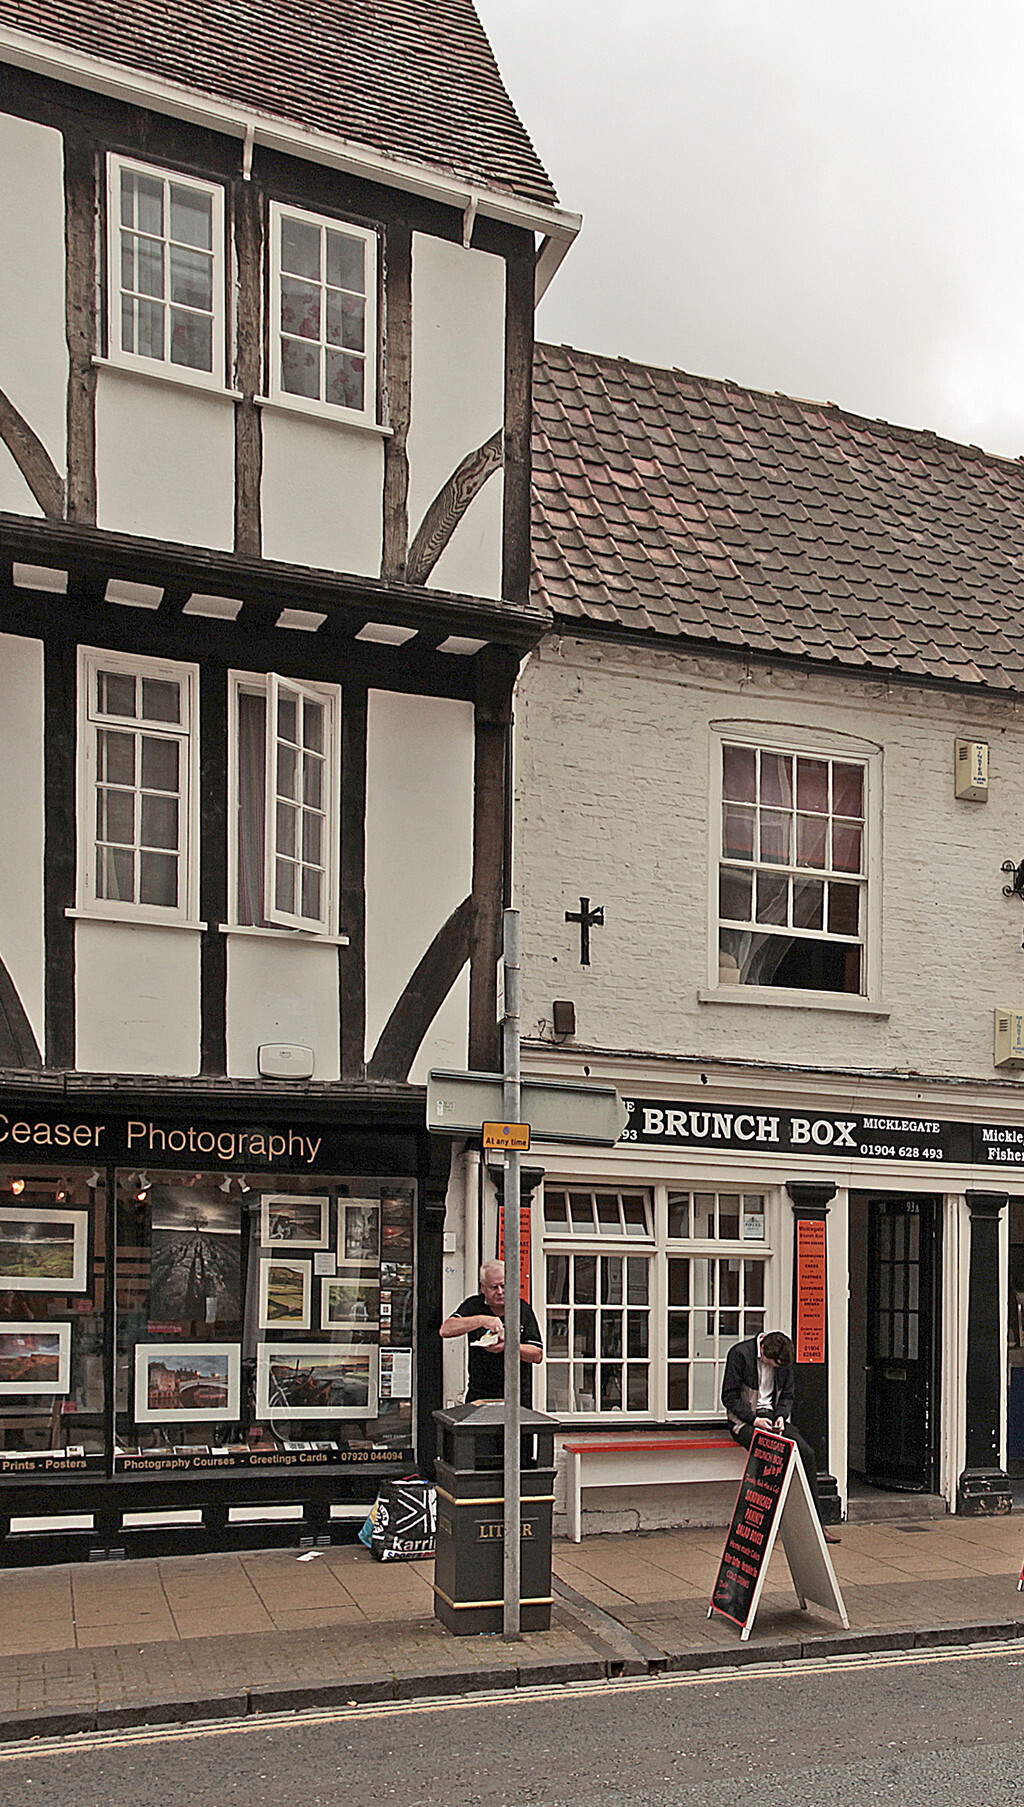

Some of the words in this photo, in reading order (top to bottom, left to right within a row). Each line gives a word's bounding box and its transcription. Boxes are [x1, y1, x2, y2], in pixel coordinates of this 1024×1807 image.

[642, 1107, 780, 1143] BRUNCH
[789, 1118, 858, 1148] BOX
[863, 1117, 941, 1134] MICKLEGATE
[127, 1121, 322, 1163] Photography
[485, 1136, 495, 1145] At
[496, 1138, 510, 1147] any
[510, 1138, 527, 1146] time
[860, 1143, 896, 1157] 01904
[899, 1146, 919, 1158] 628
[922, 1147, 943, 1160] 493
[2, 1458, 36, 1471] Prints
[45, 1459, 87, 1470] Posters
[124, 1458, 191, 1472] Photography
[193, 1457, 235, 1467] Courses
[249, 1454, 297, 1465] Greetings
[299, 1453, 328, 1462] Cards
[341, 1452, 369, 1461] 07920
[370, 1451, 403, 1461] 044094
[479, 1523, 533, 1538] LITR
[392, 1535, 437, 1551] karri
